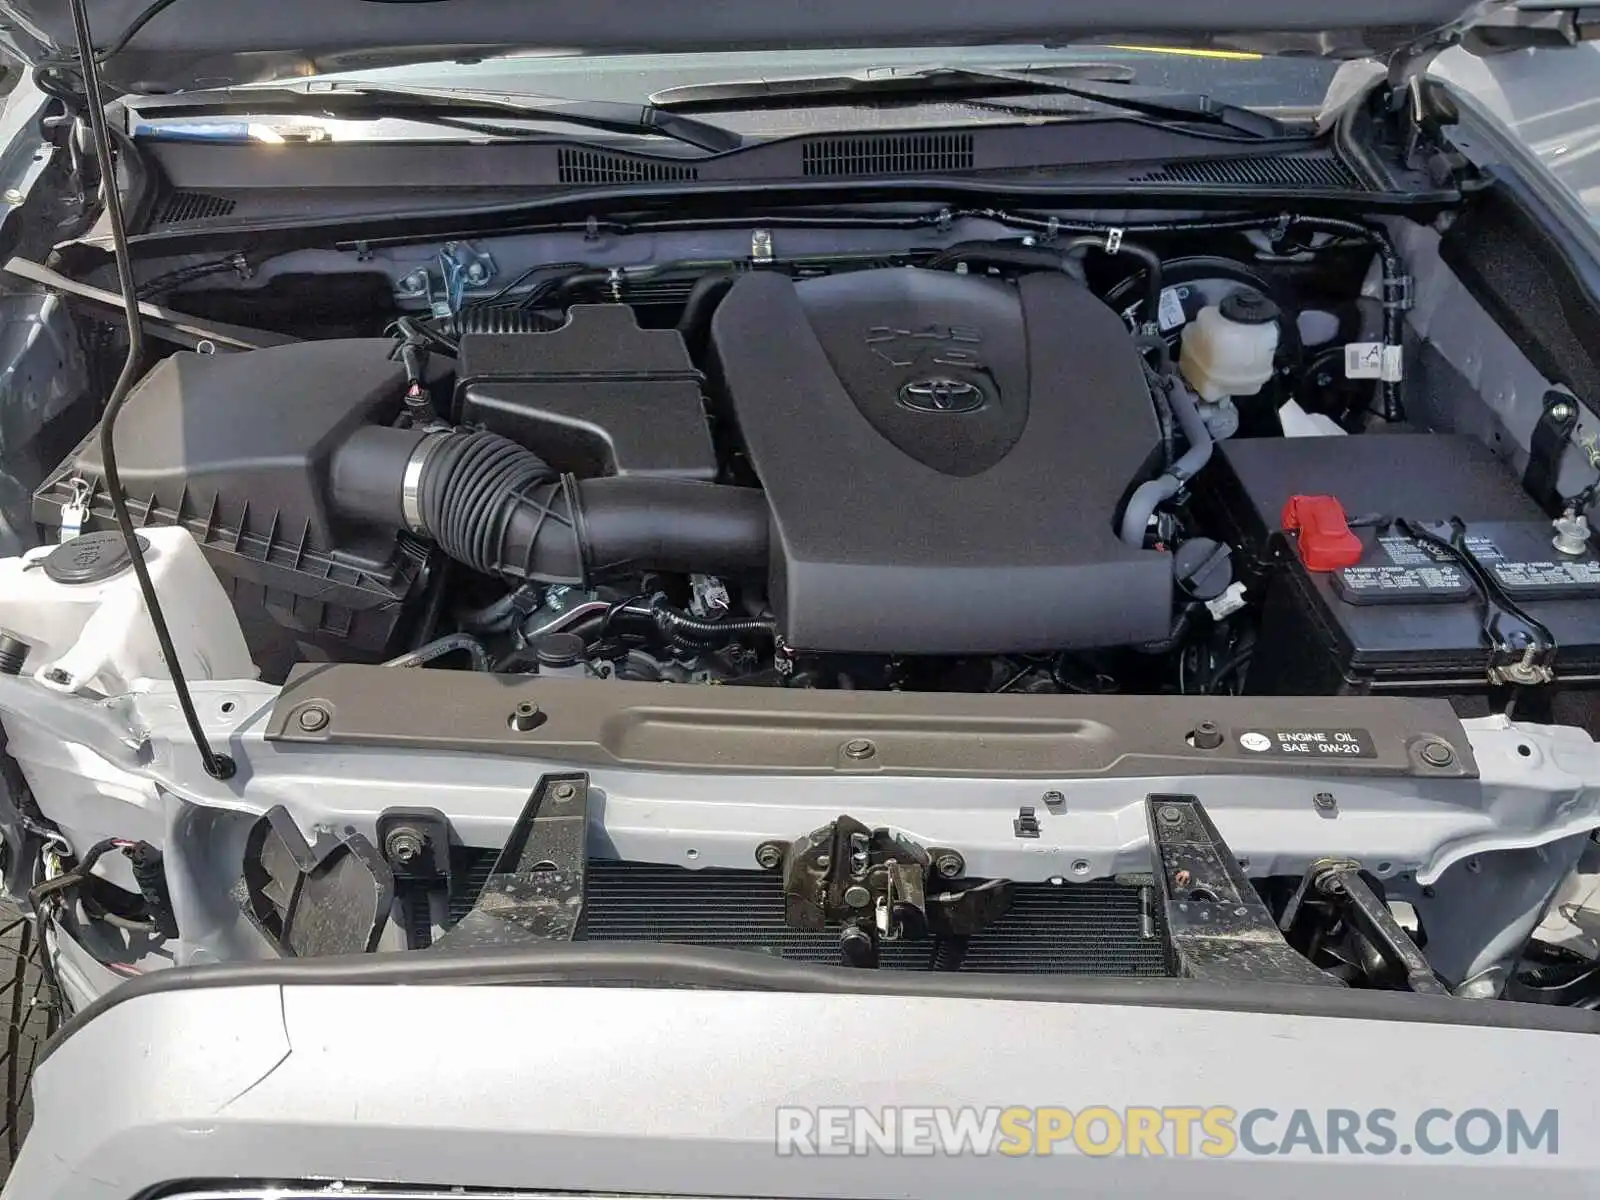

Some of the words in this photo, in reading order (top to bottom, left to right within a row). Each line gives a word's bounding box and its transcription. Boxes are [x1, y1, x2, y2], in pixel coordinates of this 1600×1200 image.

[1277, 732, 1328, 742] ENGINE
[1334, 732, 1358, 742] OIL
[1281, 743, 1310, 753] SAE
[1318, 744, 1360, 754] 0W-20
